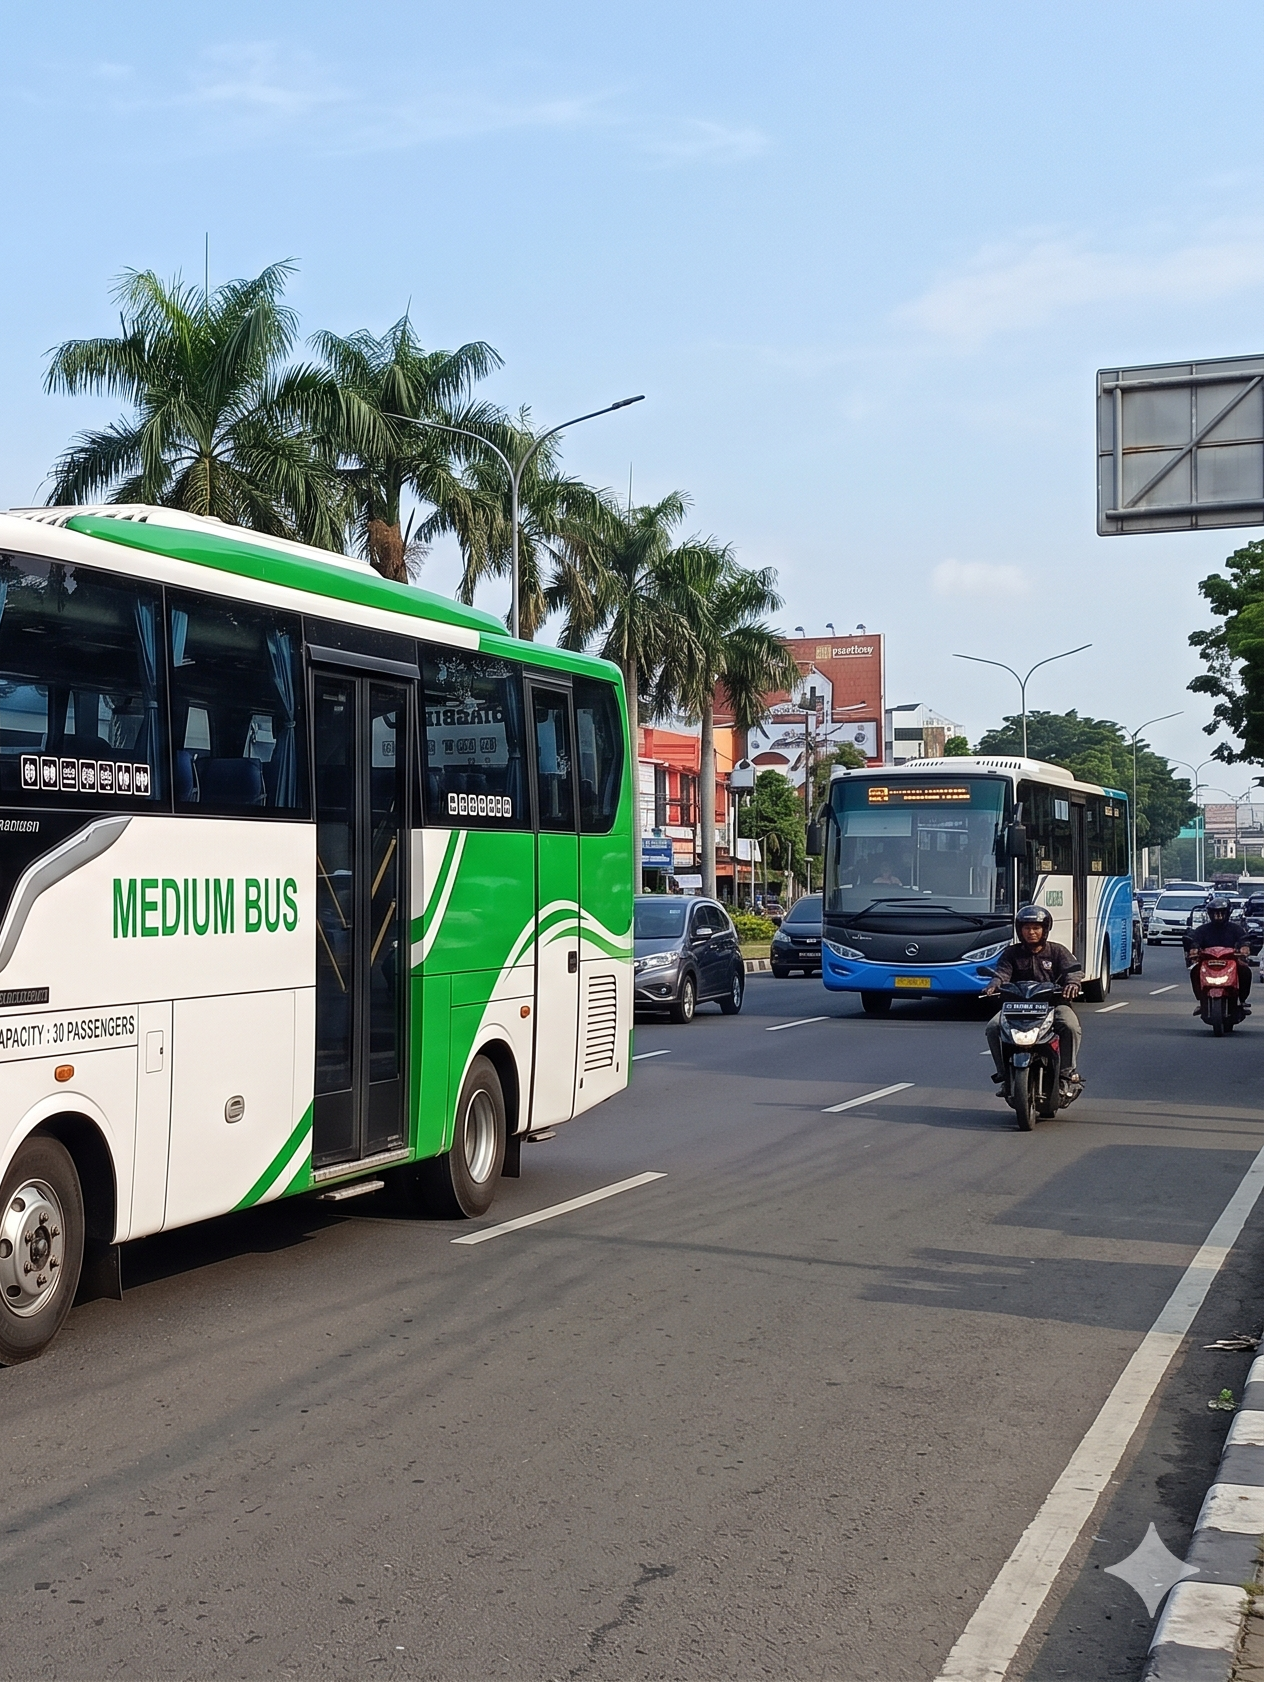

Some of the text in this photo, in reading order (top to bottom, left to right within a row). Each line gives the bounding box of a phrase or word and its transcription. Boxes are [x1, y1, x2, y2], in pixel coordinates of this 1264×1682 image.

[113, 877, 298, 939] MEDIUM BUS
[52, 1022, 65, 1043] 30
[66, 1015, 135, 1042] PASSENGERS
